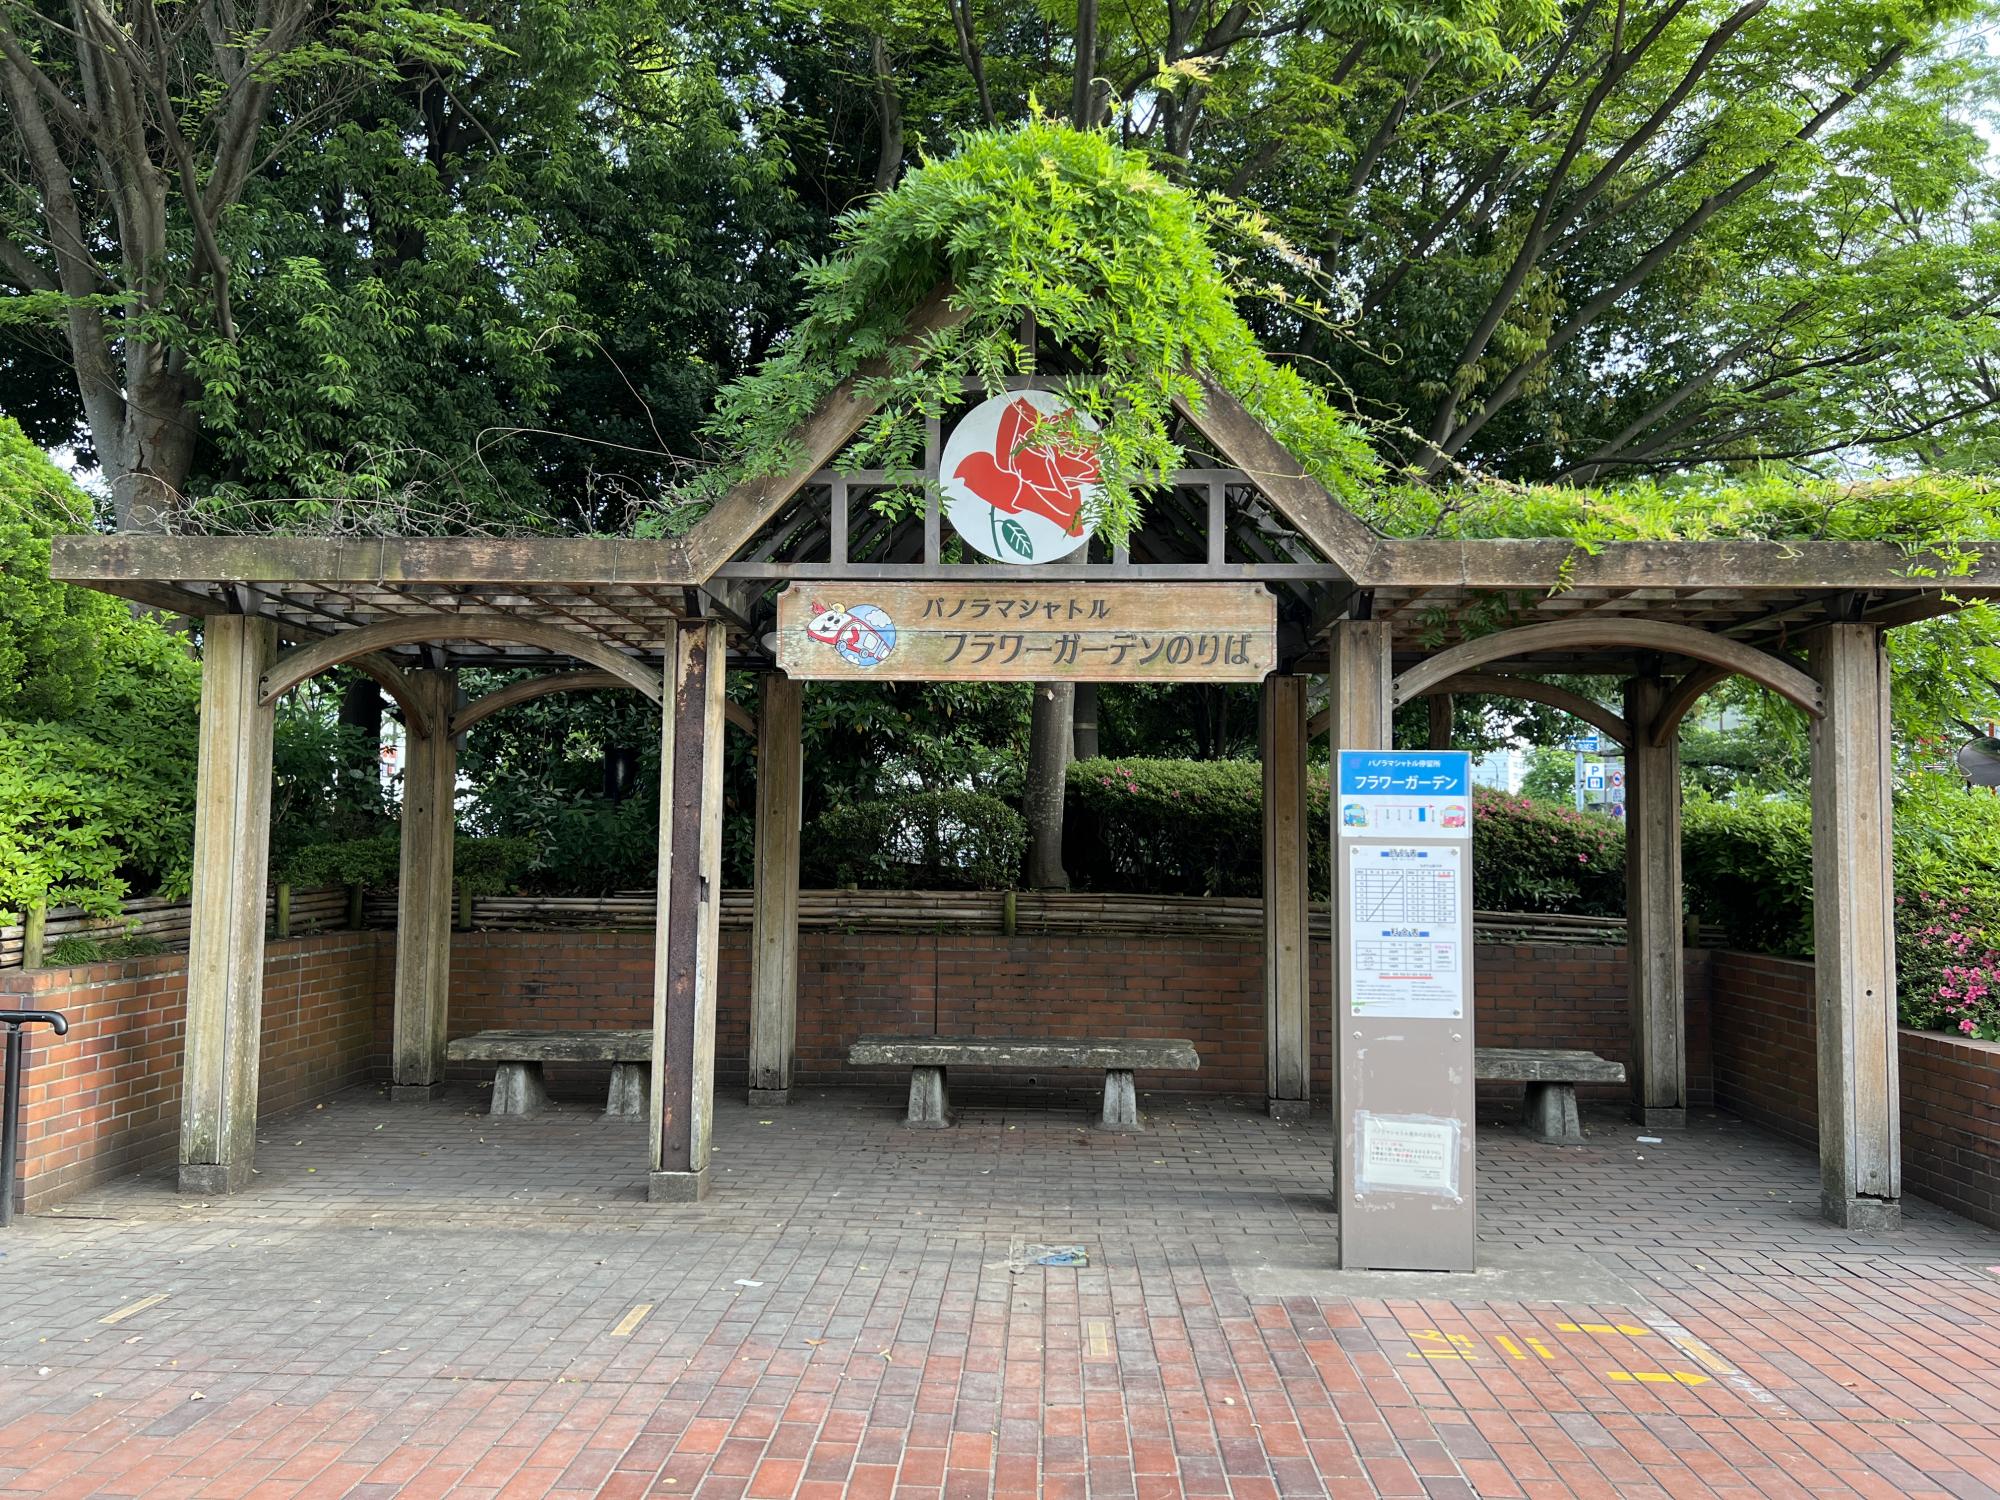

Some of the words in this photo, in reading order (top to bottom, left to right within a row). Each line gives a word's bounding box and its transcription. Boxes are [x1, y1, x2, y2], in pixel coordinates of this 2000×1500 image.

[922, 598, 1111, 620] パノラマシャトル
[943, 633, 1253, 666] フラワーガーデンのりば
[1592, 766, 1599, 775] P
[1354, 774, 1458, 790] フラワーガーデン
